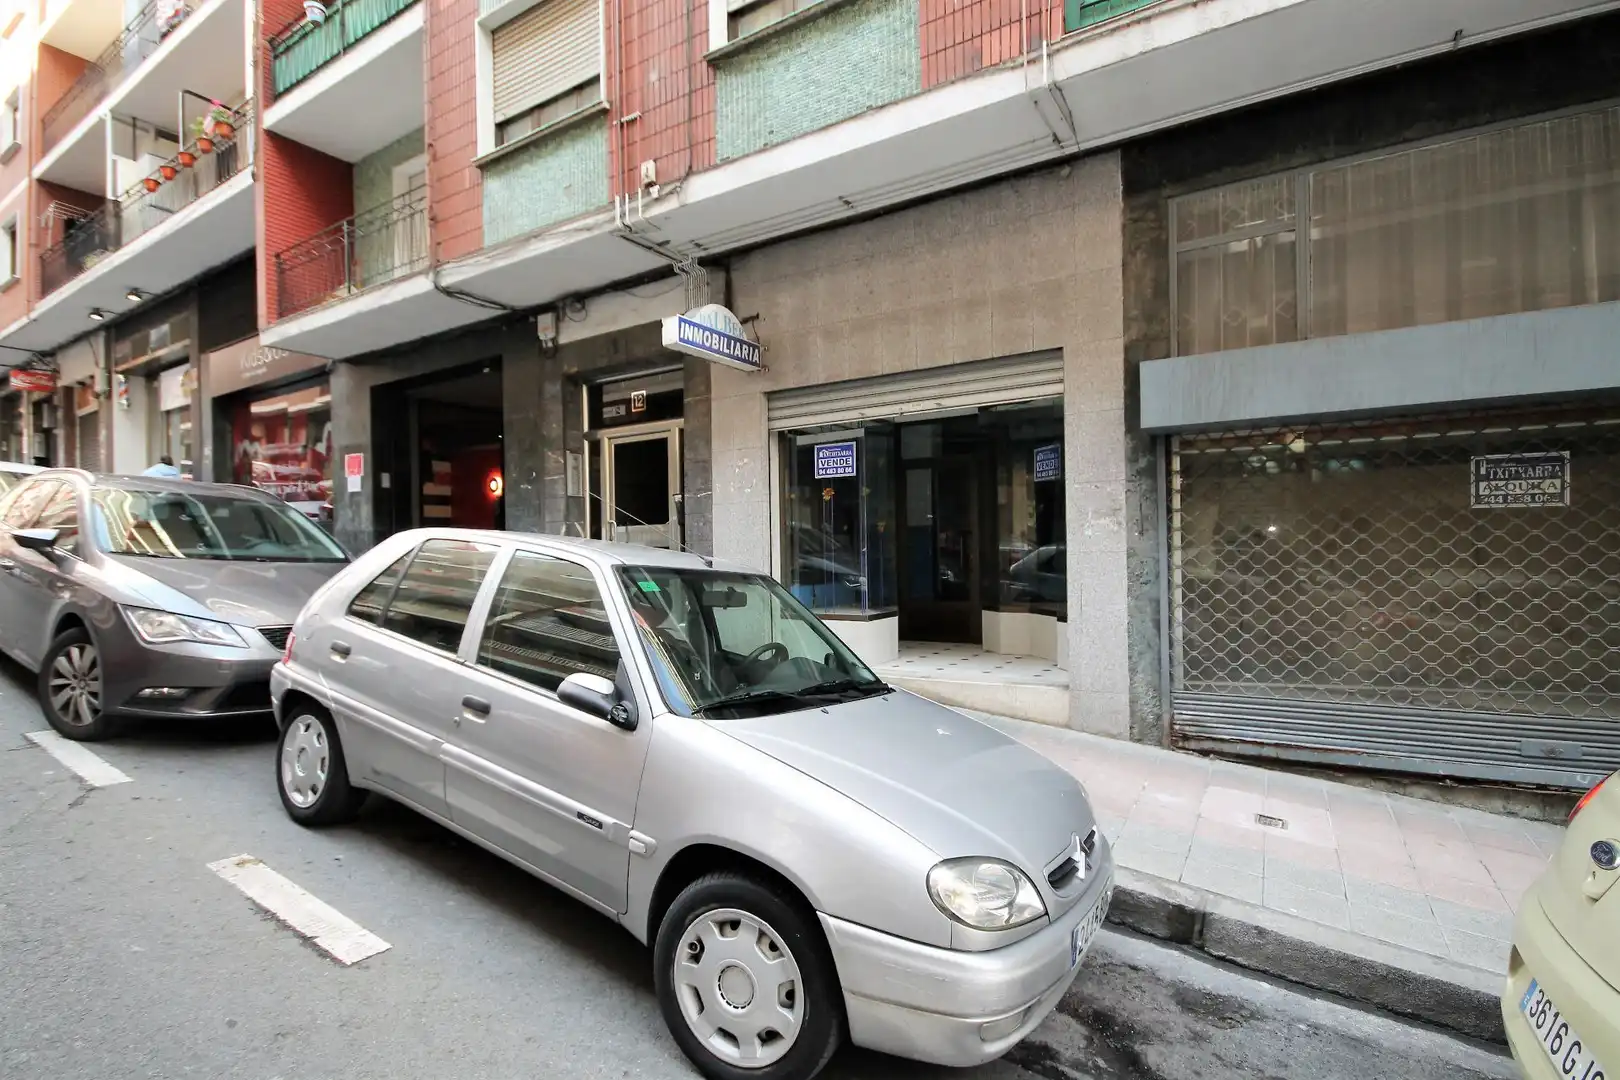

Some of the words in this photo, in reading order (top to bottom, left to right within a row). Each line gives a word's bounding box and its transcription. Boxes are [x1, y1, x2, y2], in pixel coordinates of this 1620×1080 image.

[680, 321, 760, 364] INMOBILIARIA
[634, 394, 644, 408] 12
[820, 458, 850, 467] VENDE
[1482, 481, 1558, 493] AQUA
[1529, 988, 1569, 1056] 3616
